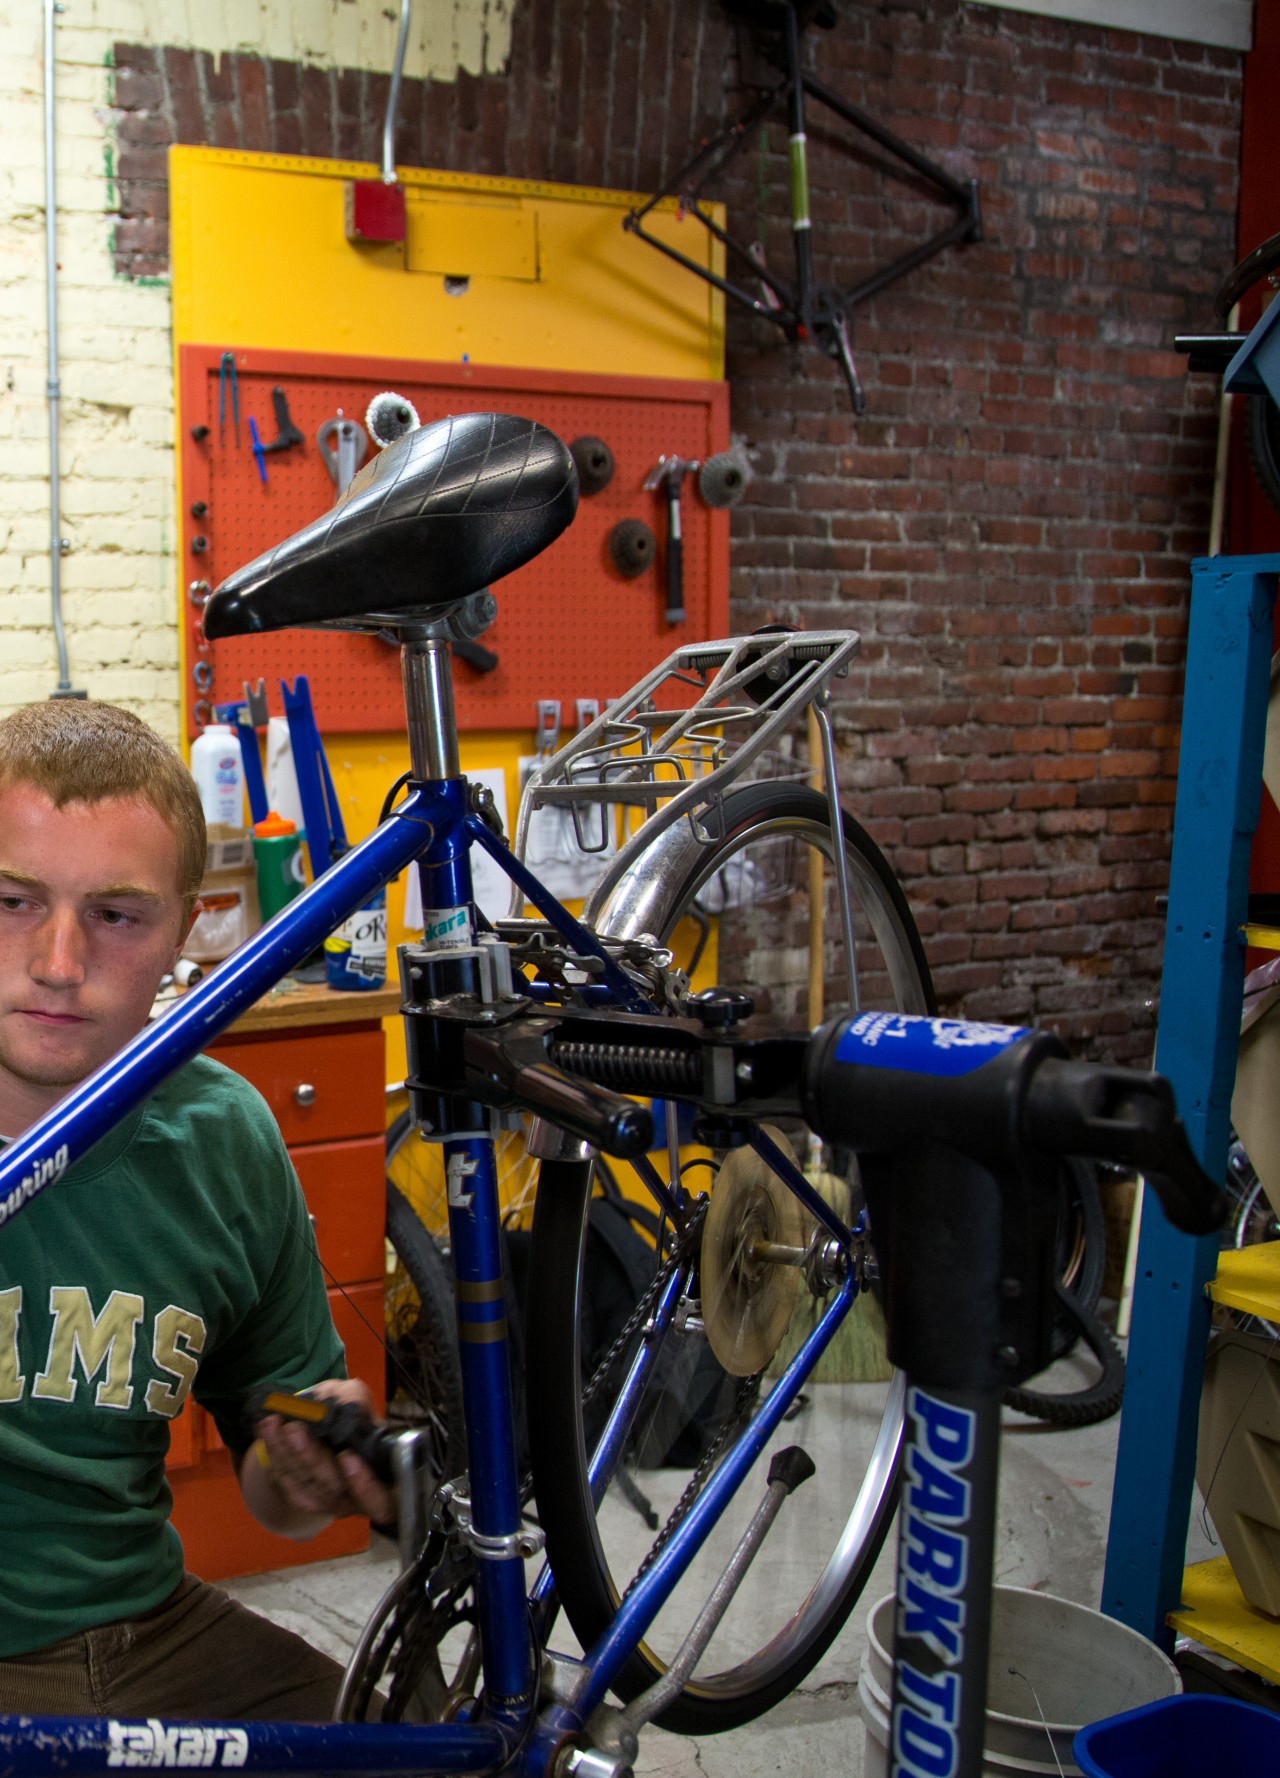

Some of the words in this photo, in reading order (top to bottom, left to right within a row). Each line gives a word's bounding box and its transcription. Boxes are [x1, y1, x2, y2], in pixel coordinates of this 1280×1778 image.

[898, 1386, 975, 1665] PARK
[107, 1718, 248, 1767] takara
[890, 1658, 962, 1778] TO
